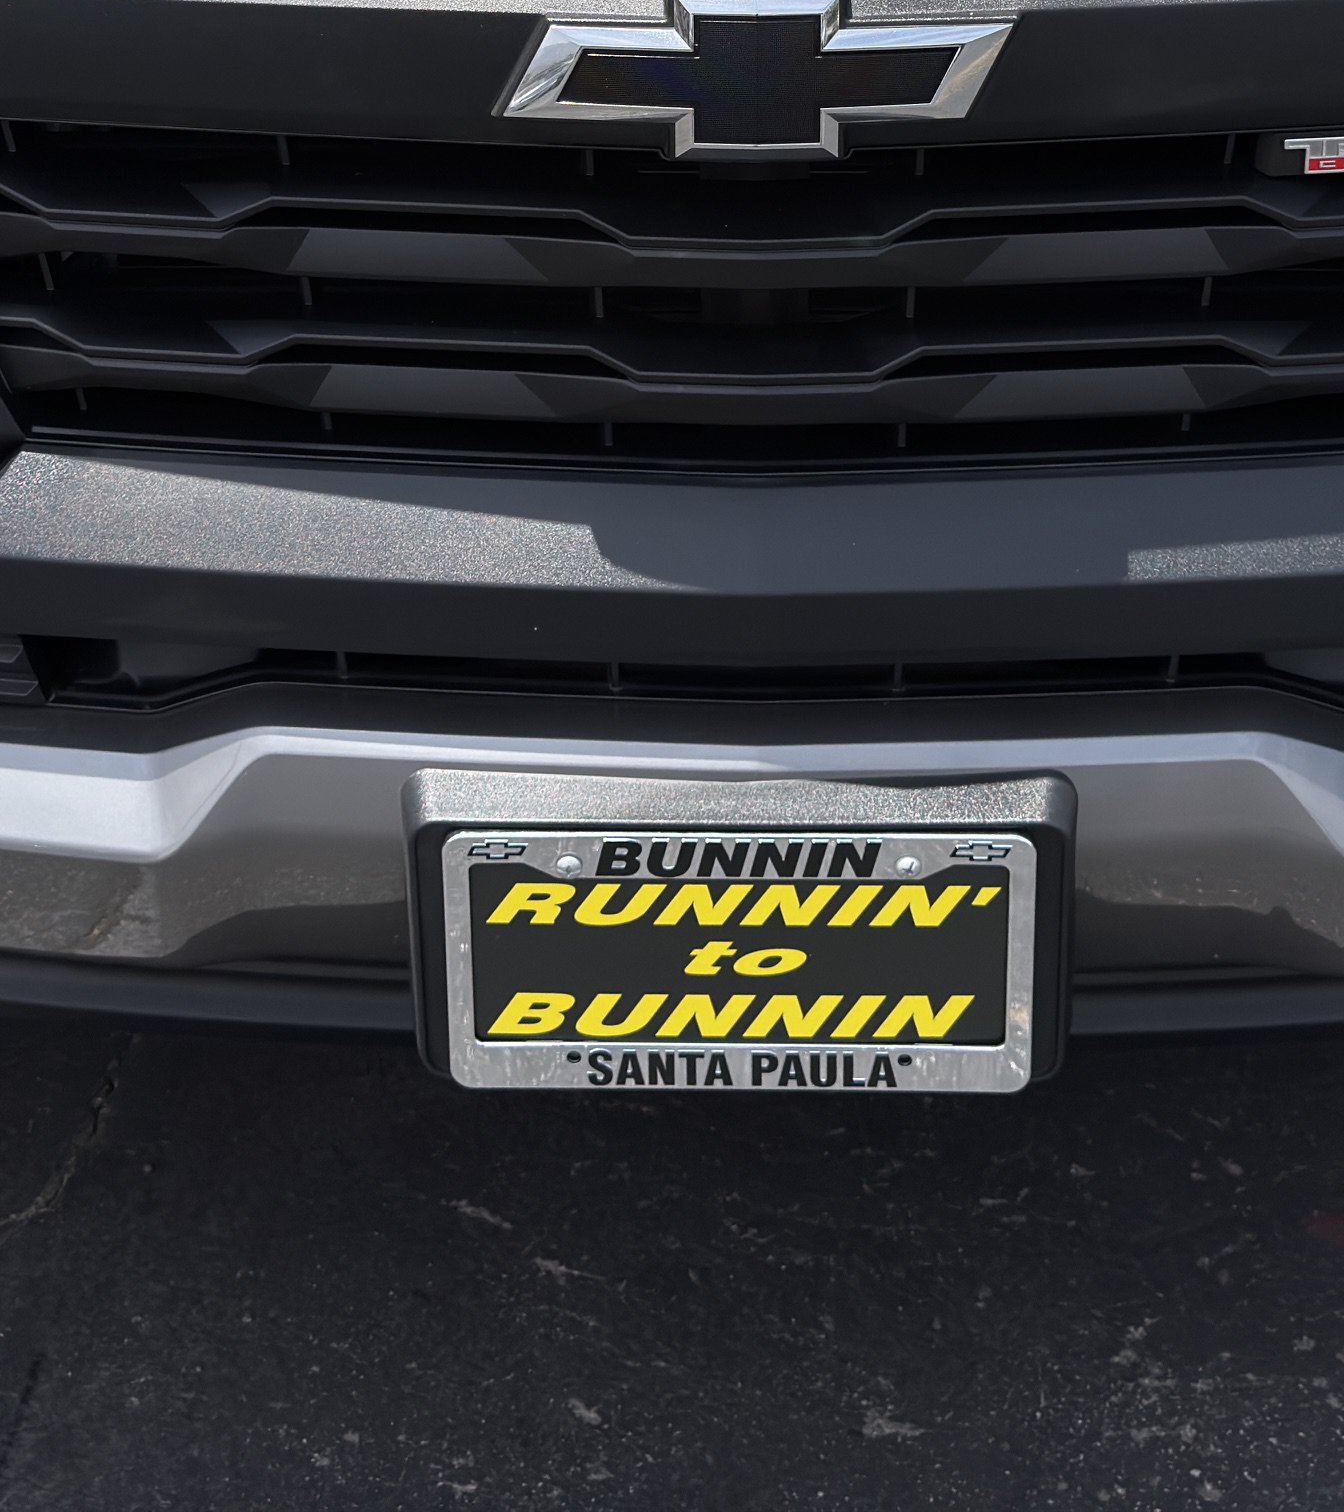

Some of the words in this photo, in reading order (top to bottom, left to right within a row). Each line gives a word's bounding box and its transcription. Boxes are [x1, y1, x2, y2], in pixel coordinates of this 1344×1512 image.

[595, 839, 881, 879] BUNNIN
[486, 882, 1003, 928] RUNNIN'
[683, 940, 809, 977] to
[486, 992, 977, 1040] BUNNIN
[587, 1049, 734, 1087] SANTA
[752, 1050, 898, 1088] PAULA
